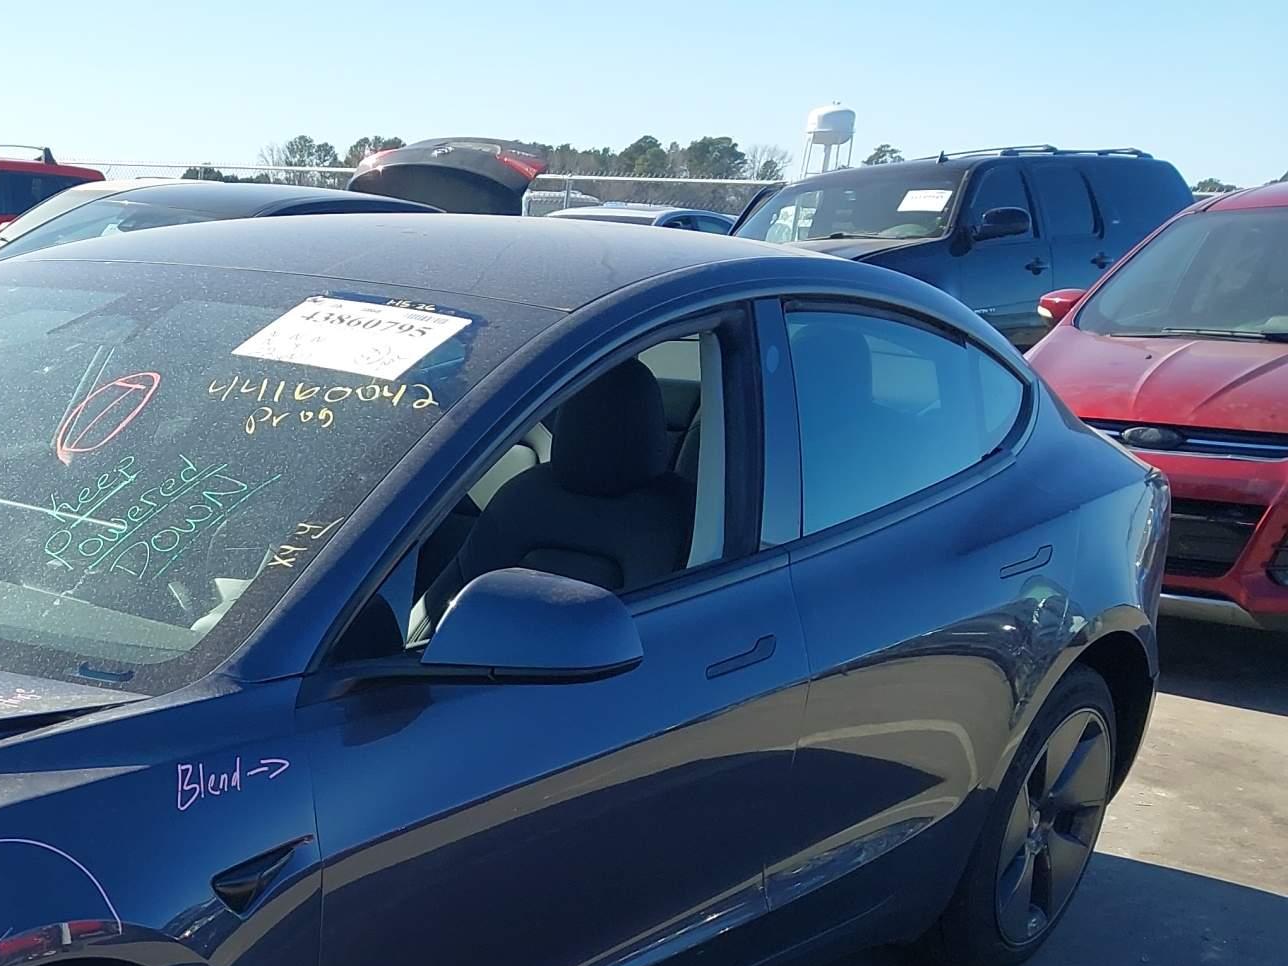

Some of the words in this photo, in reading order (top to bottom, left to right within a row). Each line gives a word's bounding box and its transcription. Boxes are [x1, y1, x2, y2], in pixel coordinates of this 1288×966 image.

[300, 310, 433, 338] 43860795
[208, 376, 439, 409] 44160042
[177, 756, 242, 811] Blend
